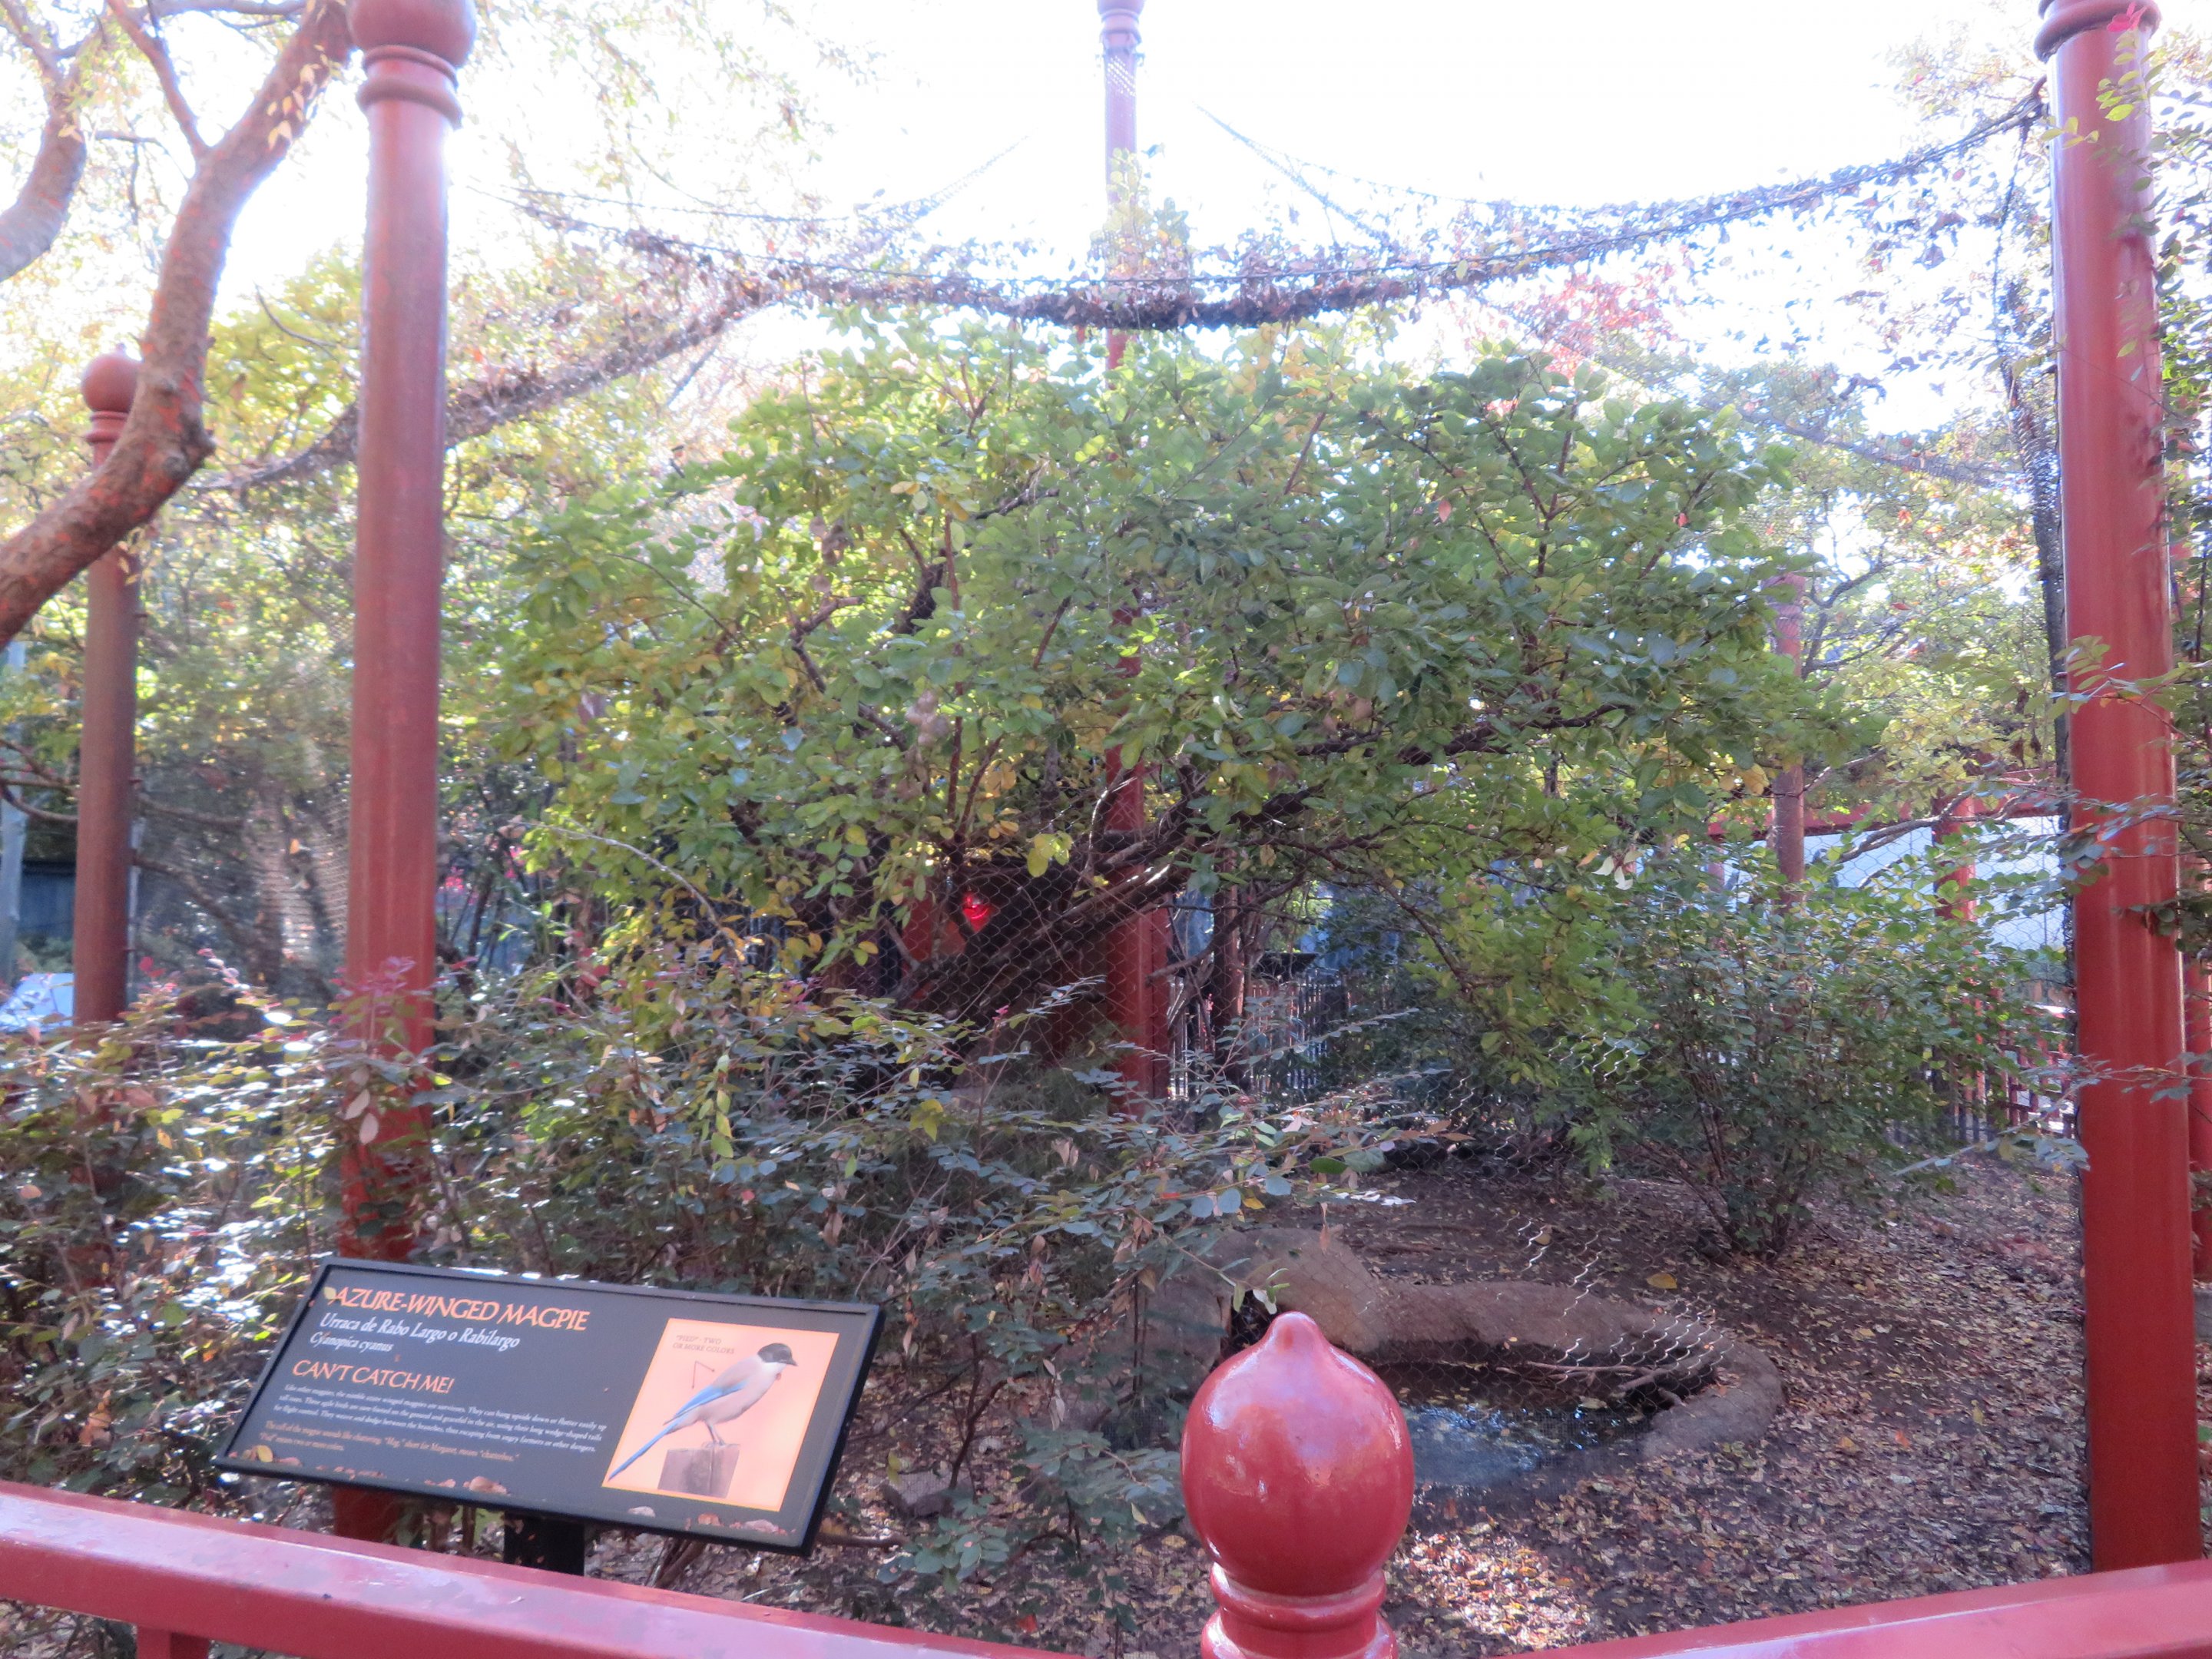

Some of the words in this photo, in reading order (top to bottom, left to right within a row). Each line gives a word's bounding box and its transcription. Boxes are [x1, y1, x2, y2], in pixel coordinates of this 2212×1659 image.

[328, 1286, 500, 1321] AZURE-WINGED
[496, 1303, 591, 1331] MAGPIE
[320, 1312, 361, 1330] Urraca
[360, 1316, 377, 1333] de
[377, 1319, 410, 1336] Rabo
[409, 1322, 447, 1343] Largo
[448, 1331, 458, 1341] o
[458, 1327, 521, 1352] Rabilargo
[359, 1342, 394, 1353] cyanus
[293, 1359, 353, 1382] CAN'T
[352, 1366, 421, 1389] CATCH
[416, 1375, 455, 1394] ME!
